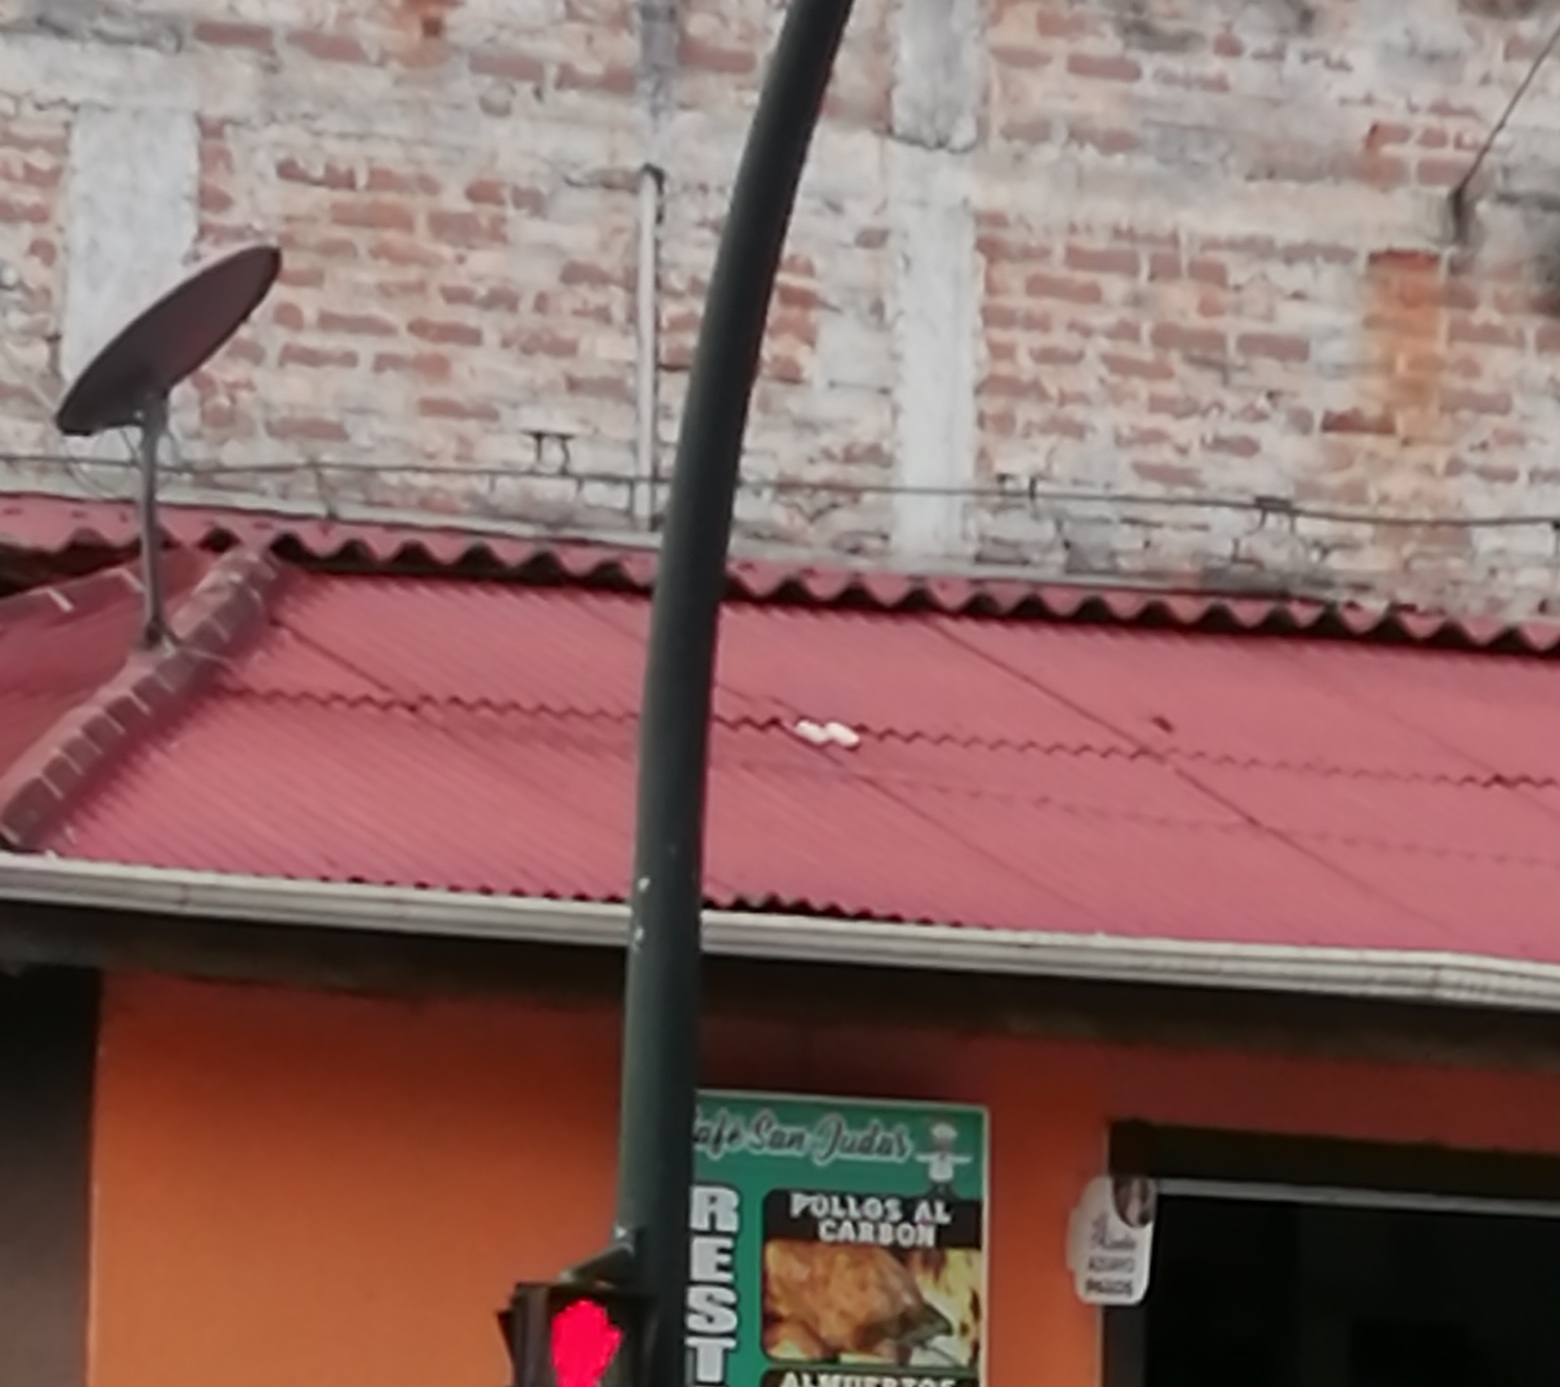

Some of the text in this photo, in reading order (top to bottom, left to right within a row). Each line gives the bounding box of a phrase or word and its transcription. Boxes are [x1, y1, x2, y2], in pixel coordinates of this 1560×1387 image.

[750, 1108, 806, 1157] San
[811, 1112, 916, 1166] Judas
[790, 1192, 951, 1225] POLLOS AL
[818, 1219, 936, 1247] CARBON
